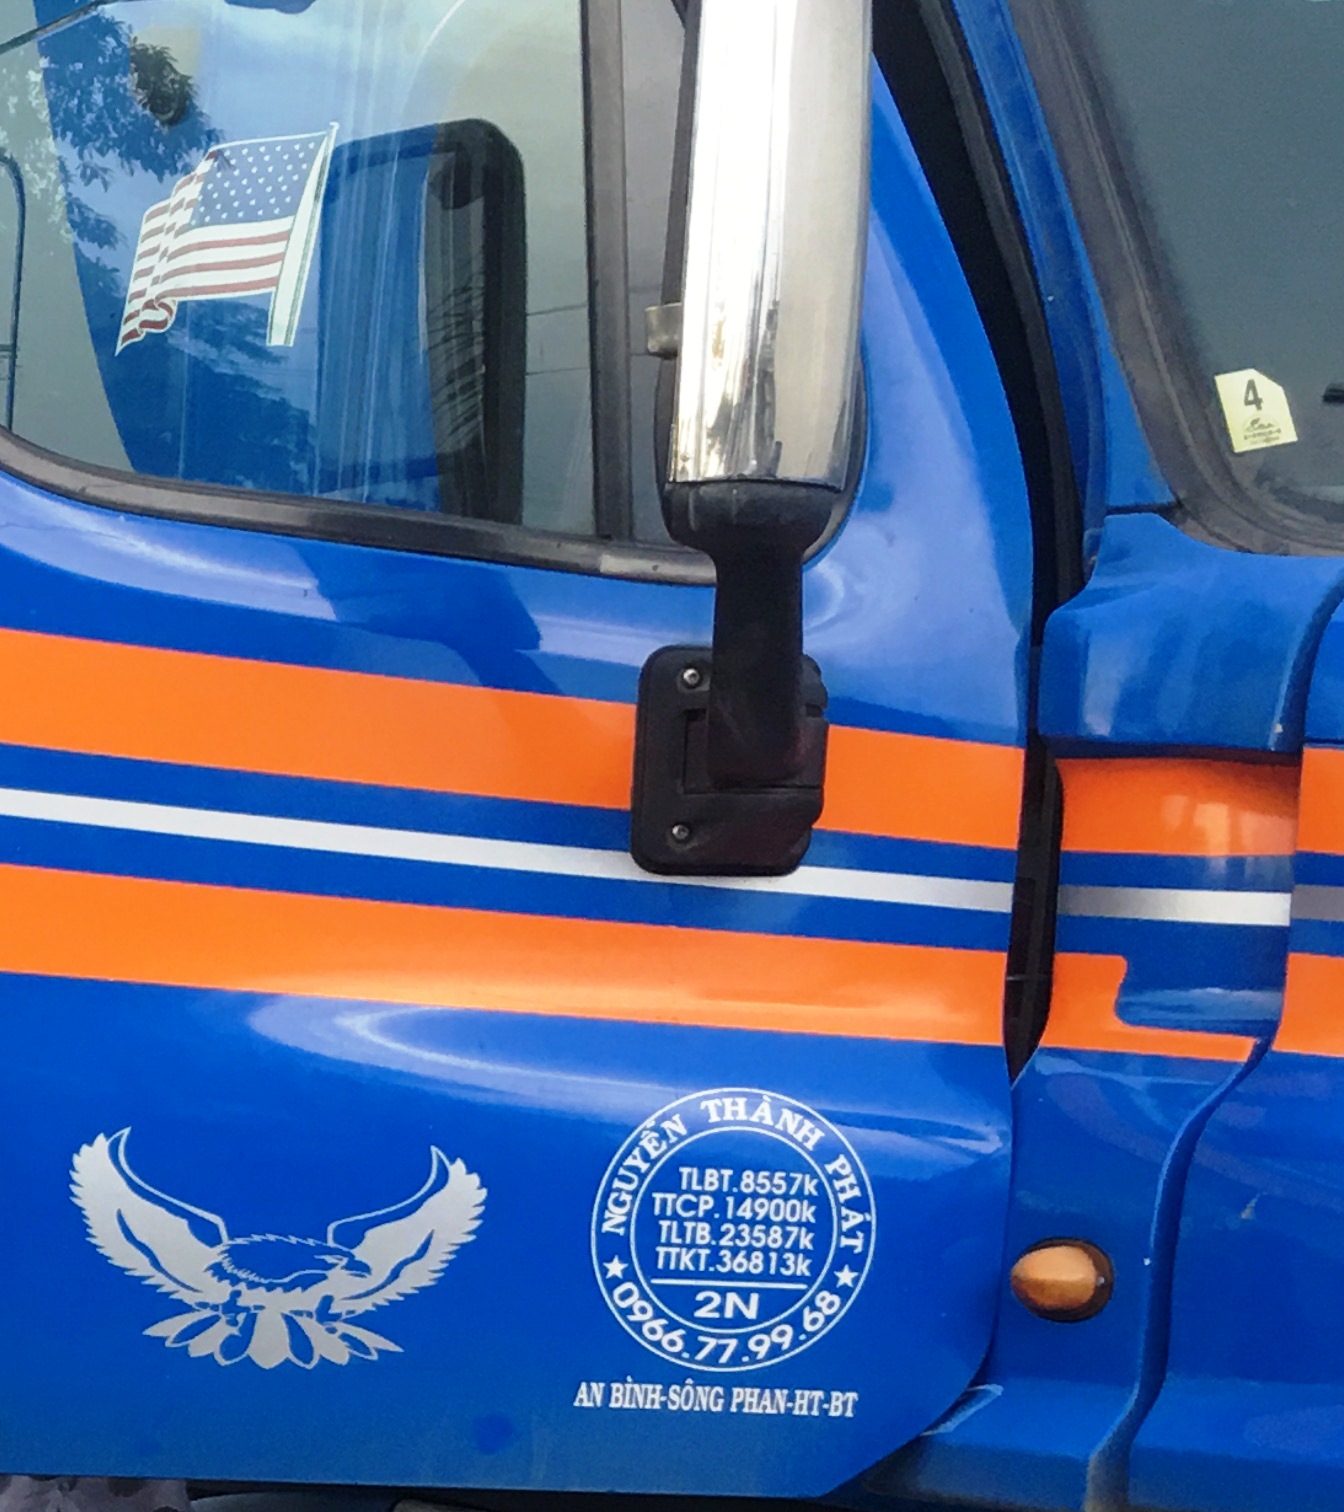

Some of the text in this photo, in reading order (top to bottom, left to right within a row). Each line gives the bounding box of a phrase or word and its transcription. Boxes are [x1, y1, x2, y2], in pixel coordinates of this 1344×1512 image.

[1243, 378, 1263, 411] 4
[678, 1166, 819, 1197] TLBT.8557k
[700, 1095, 826, 1151] THÀNH
[824, 1153, 872, 1255] PHÁT
[652, 1192, 817, 1223] TTCP.14900k
[658, 1220, 815, 1250] TLTB.23587k
[693, 1290, 760, 1320] 2N
[612, 1281, 842, 1365] 0966.77.99.68
[573, 1381, 606, 1408] AN
[730, 1386, 859, 1418] PHAN-HT-BT
